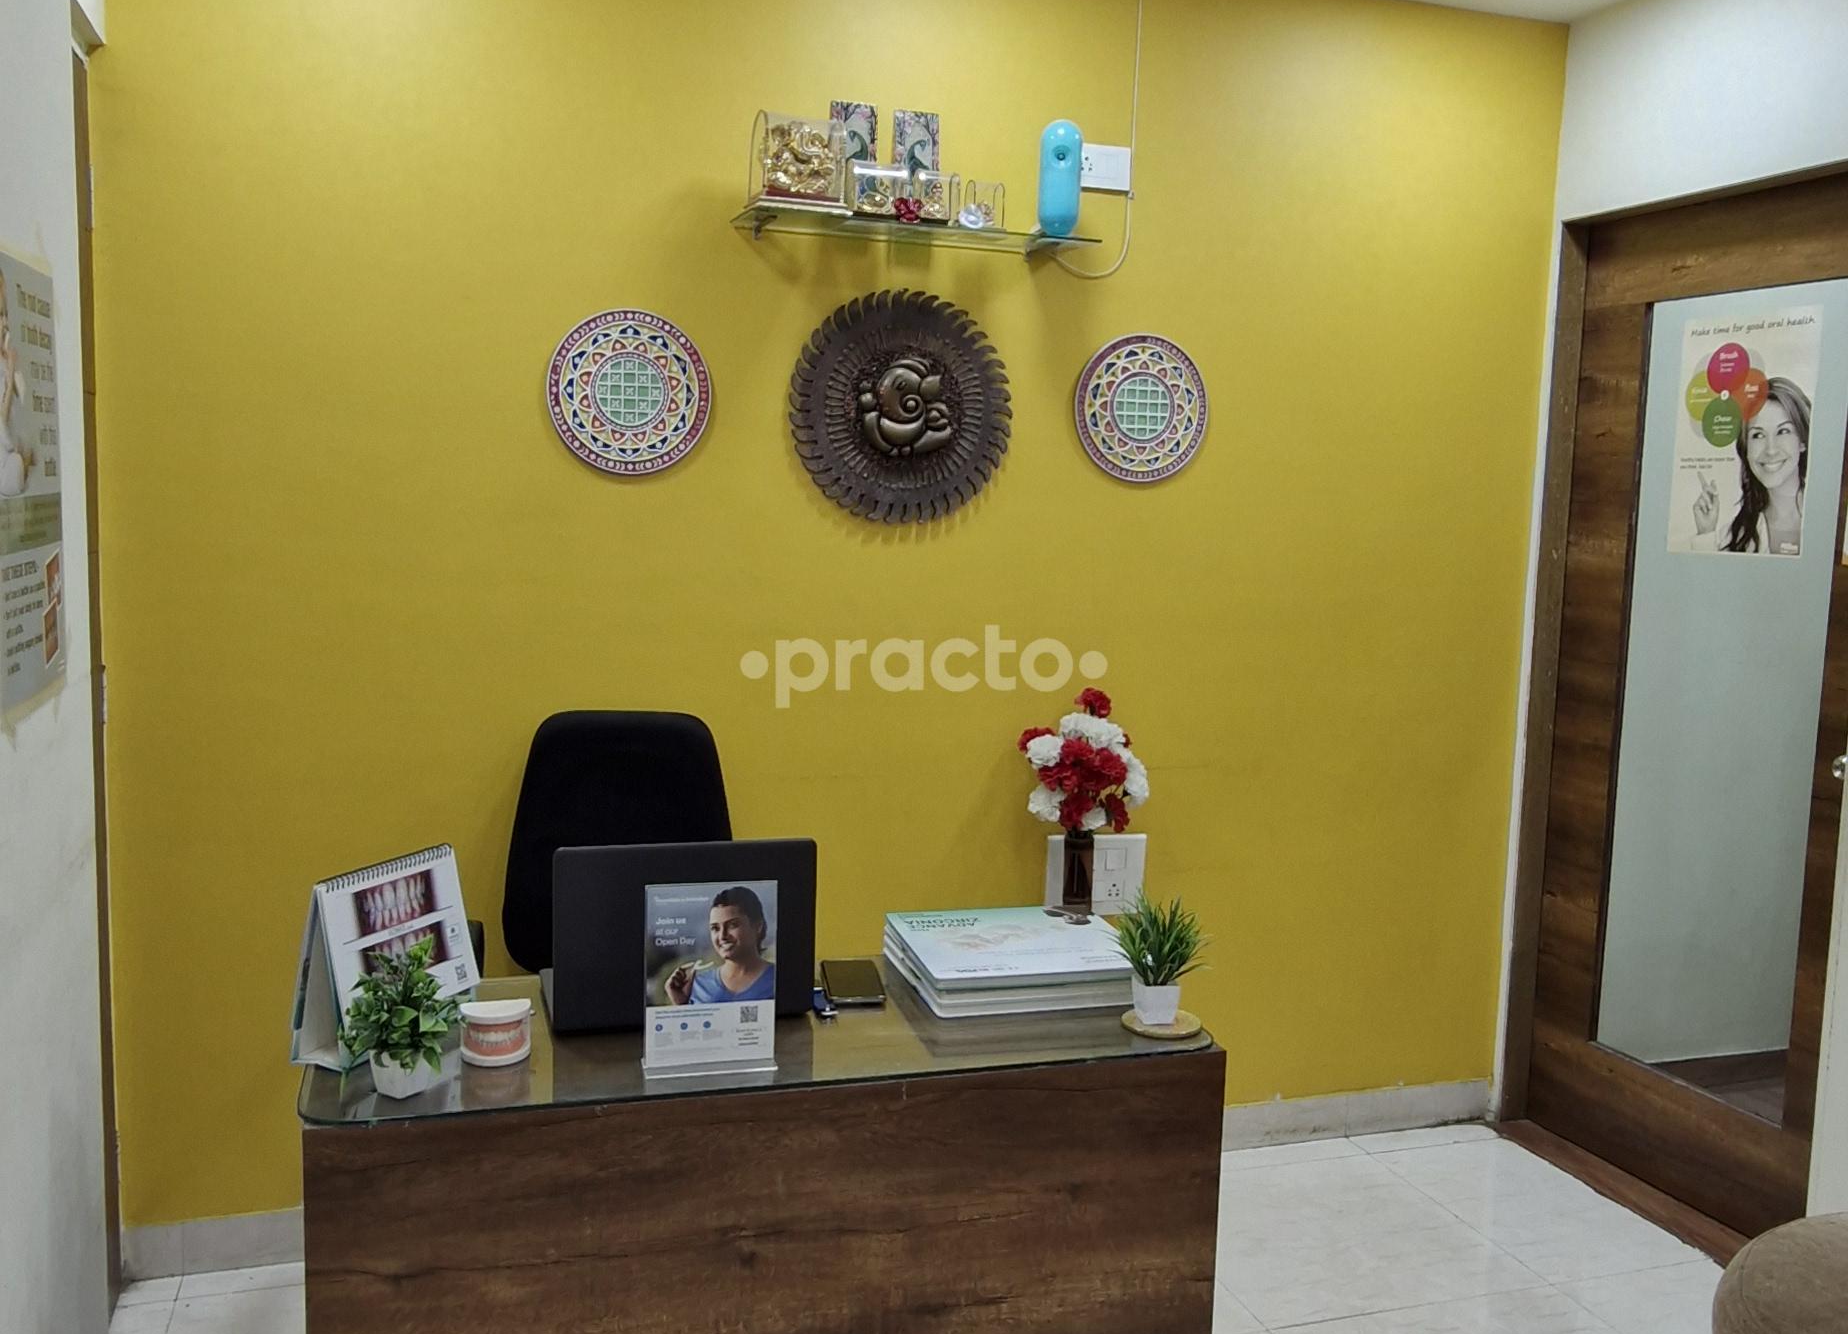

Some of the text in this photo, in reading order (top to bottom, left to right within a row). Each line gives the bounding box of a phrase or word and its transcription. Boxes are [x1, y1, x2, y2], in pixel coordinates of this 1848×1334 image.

[1690, 328, 1710, 337] Make
[1713, 326, 1730, 335] time
[1732, 323, 1744, 333] for
[1746, 320, 1765, 334] good
[1768, 318, 1785, 328] oral
[655, 916, 687, 925] Join us
[903, 917, 979, 925] ZIRCONIA
[664, 928, 679, 936] our
[655, 937, 696, 947] Open Day
